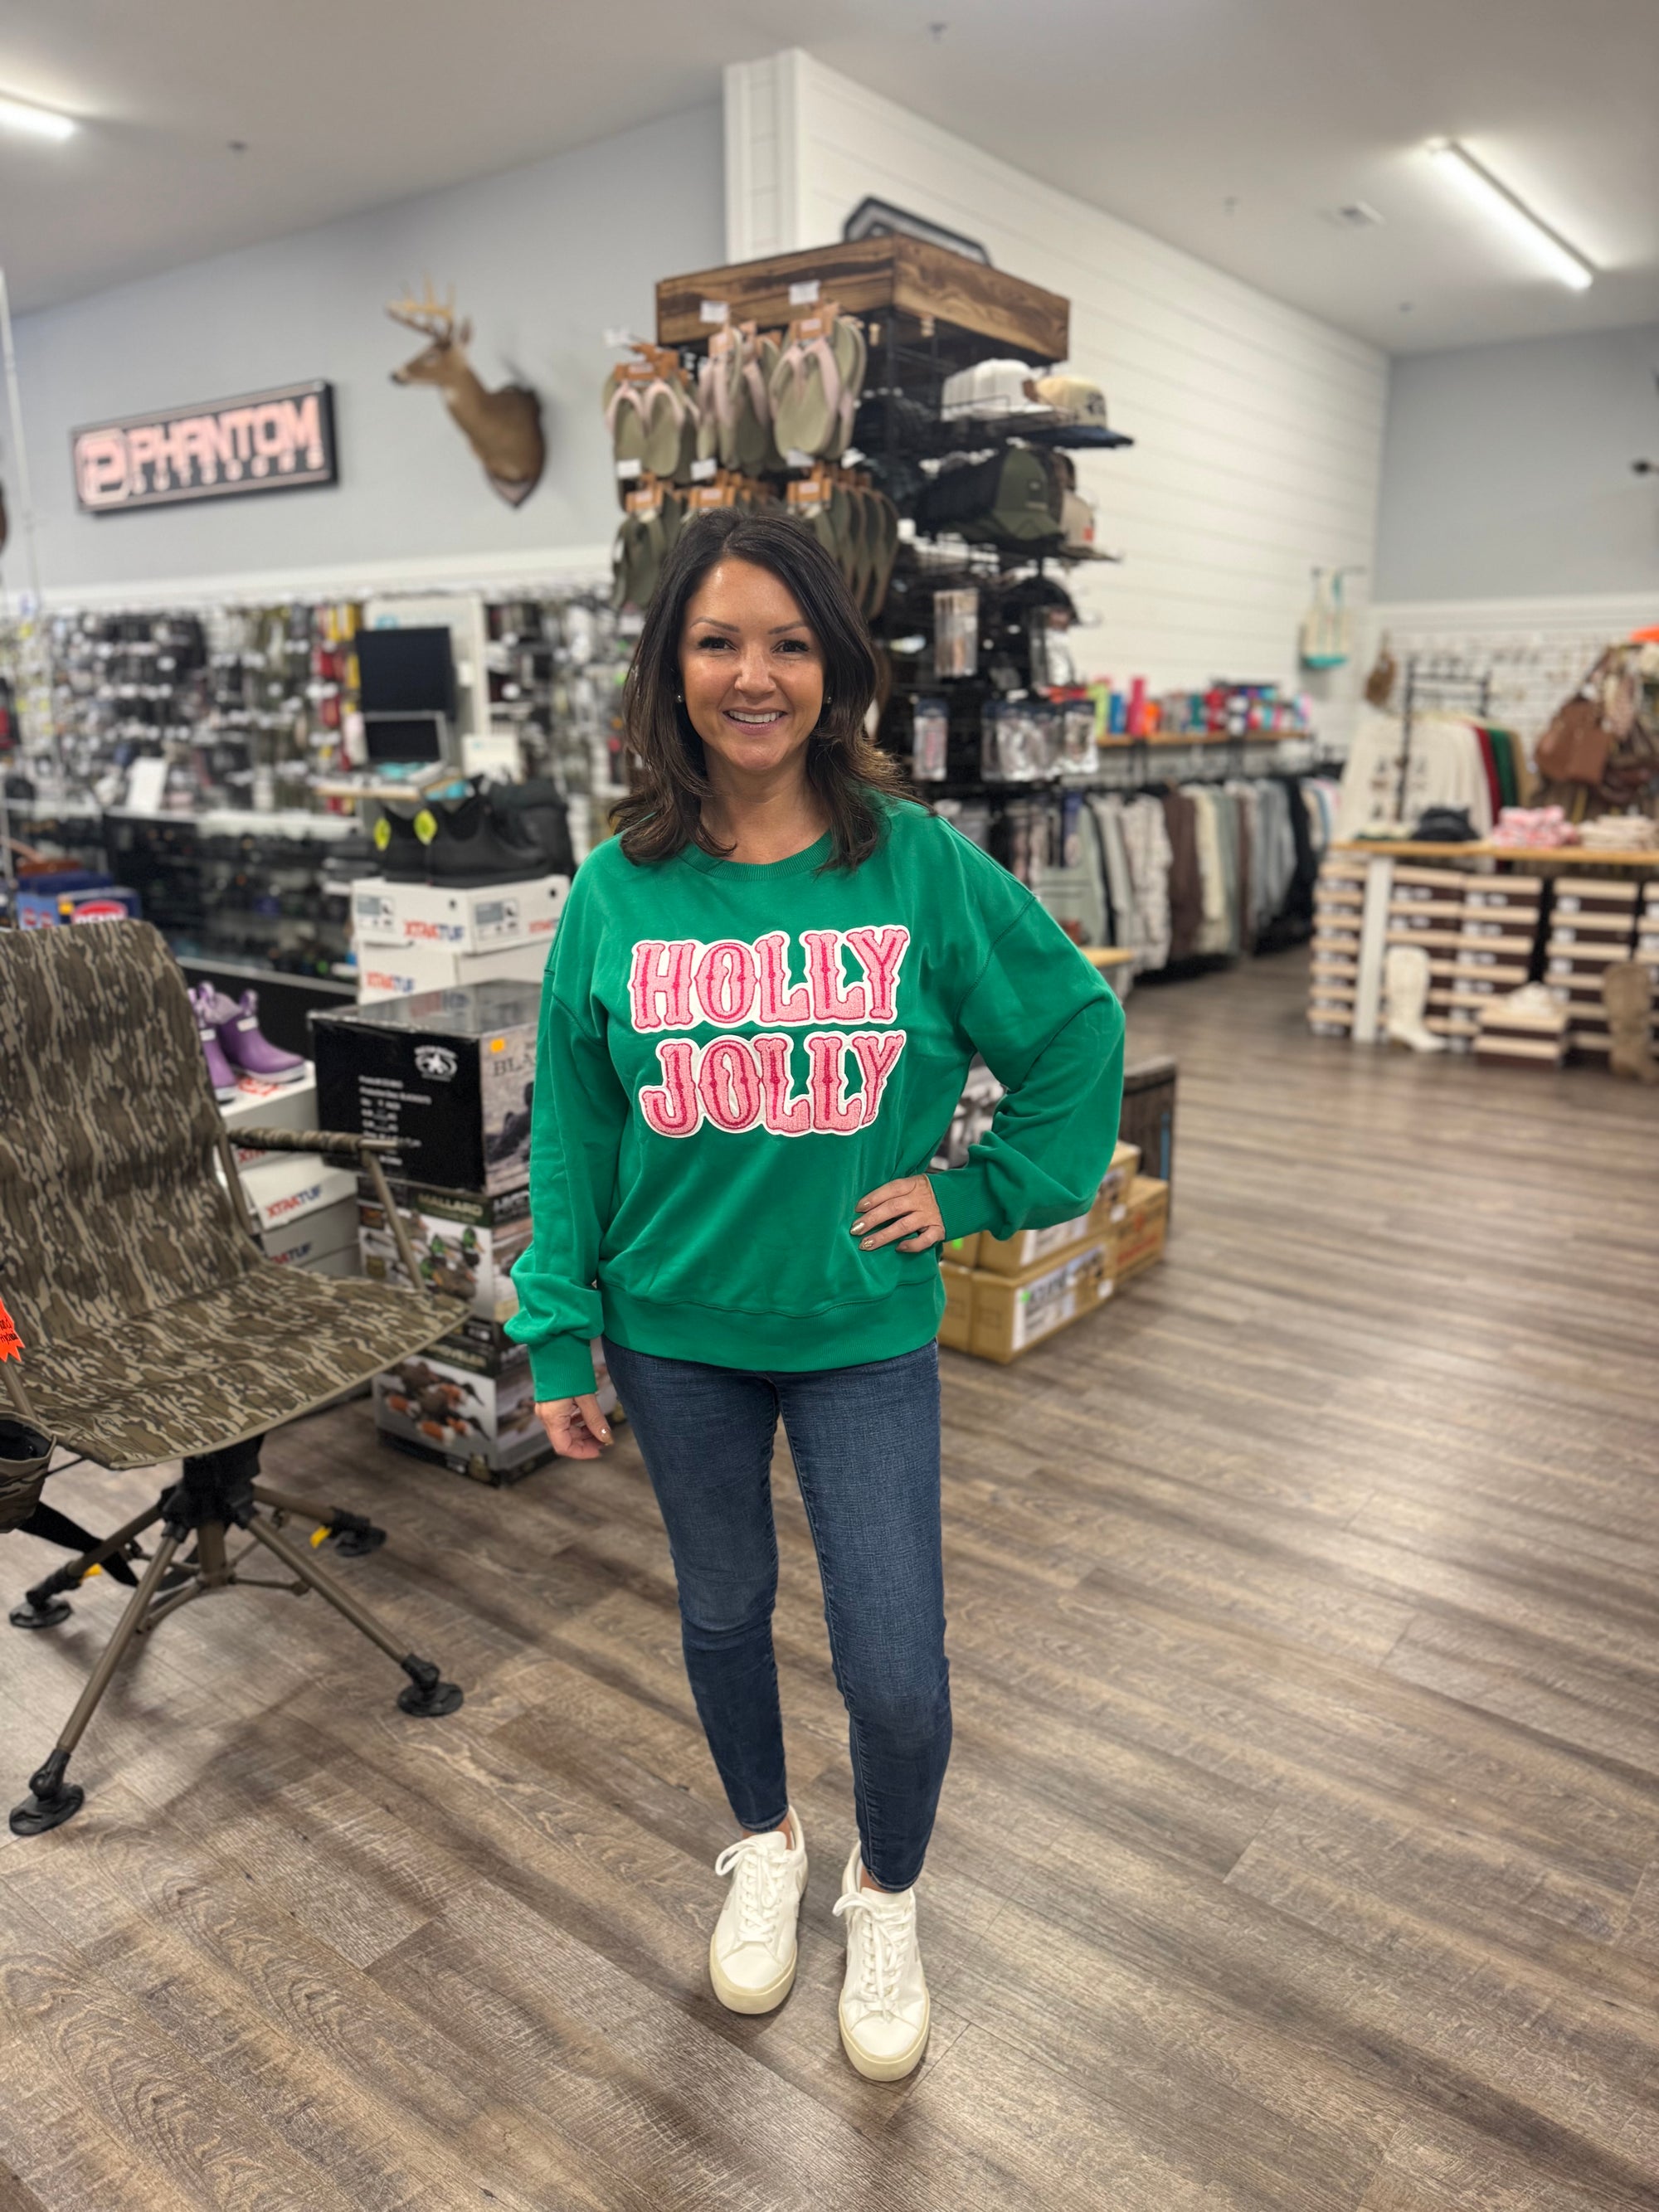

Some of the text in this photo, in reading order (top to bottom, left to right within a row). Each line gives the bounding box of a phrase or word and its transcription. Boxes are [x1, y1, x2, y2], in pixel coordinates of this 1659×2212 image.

[126, 394, 320, 478] PHANTOM
[629, 926, 910, 1032] HOLLY
[640, 1031, 906, 1138] JOLLY
[265, 1184, 323, 1218] XTRATUF
